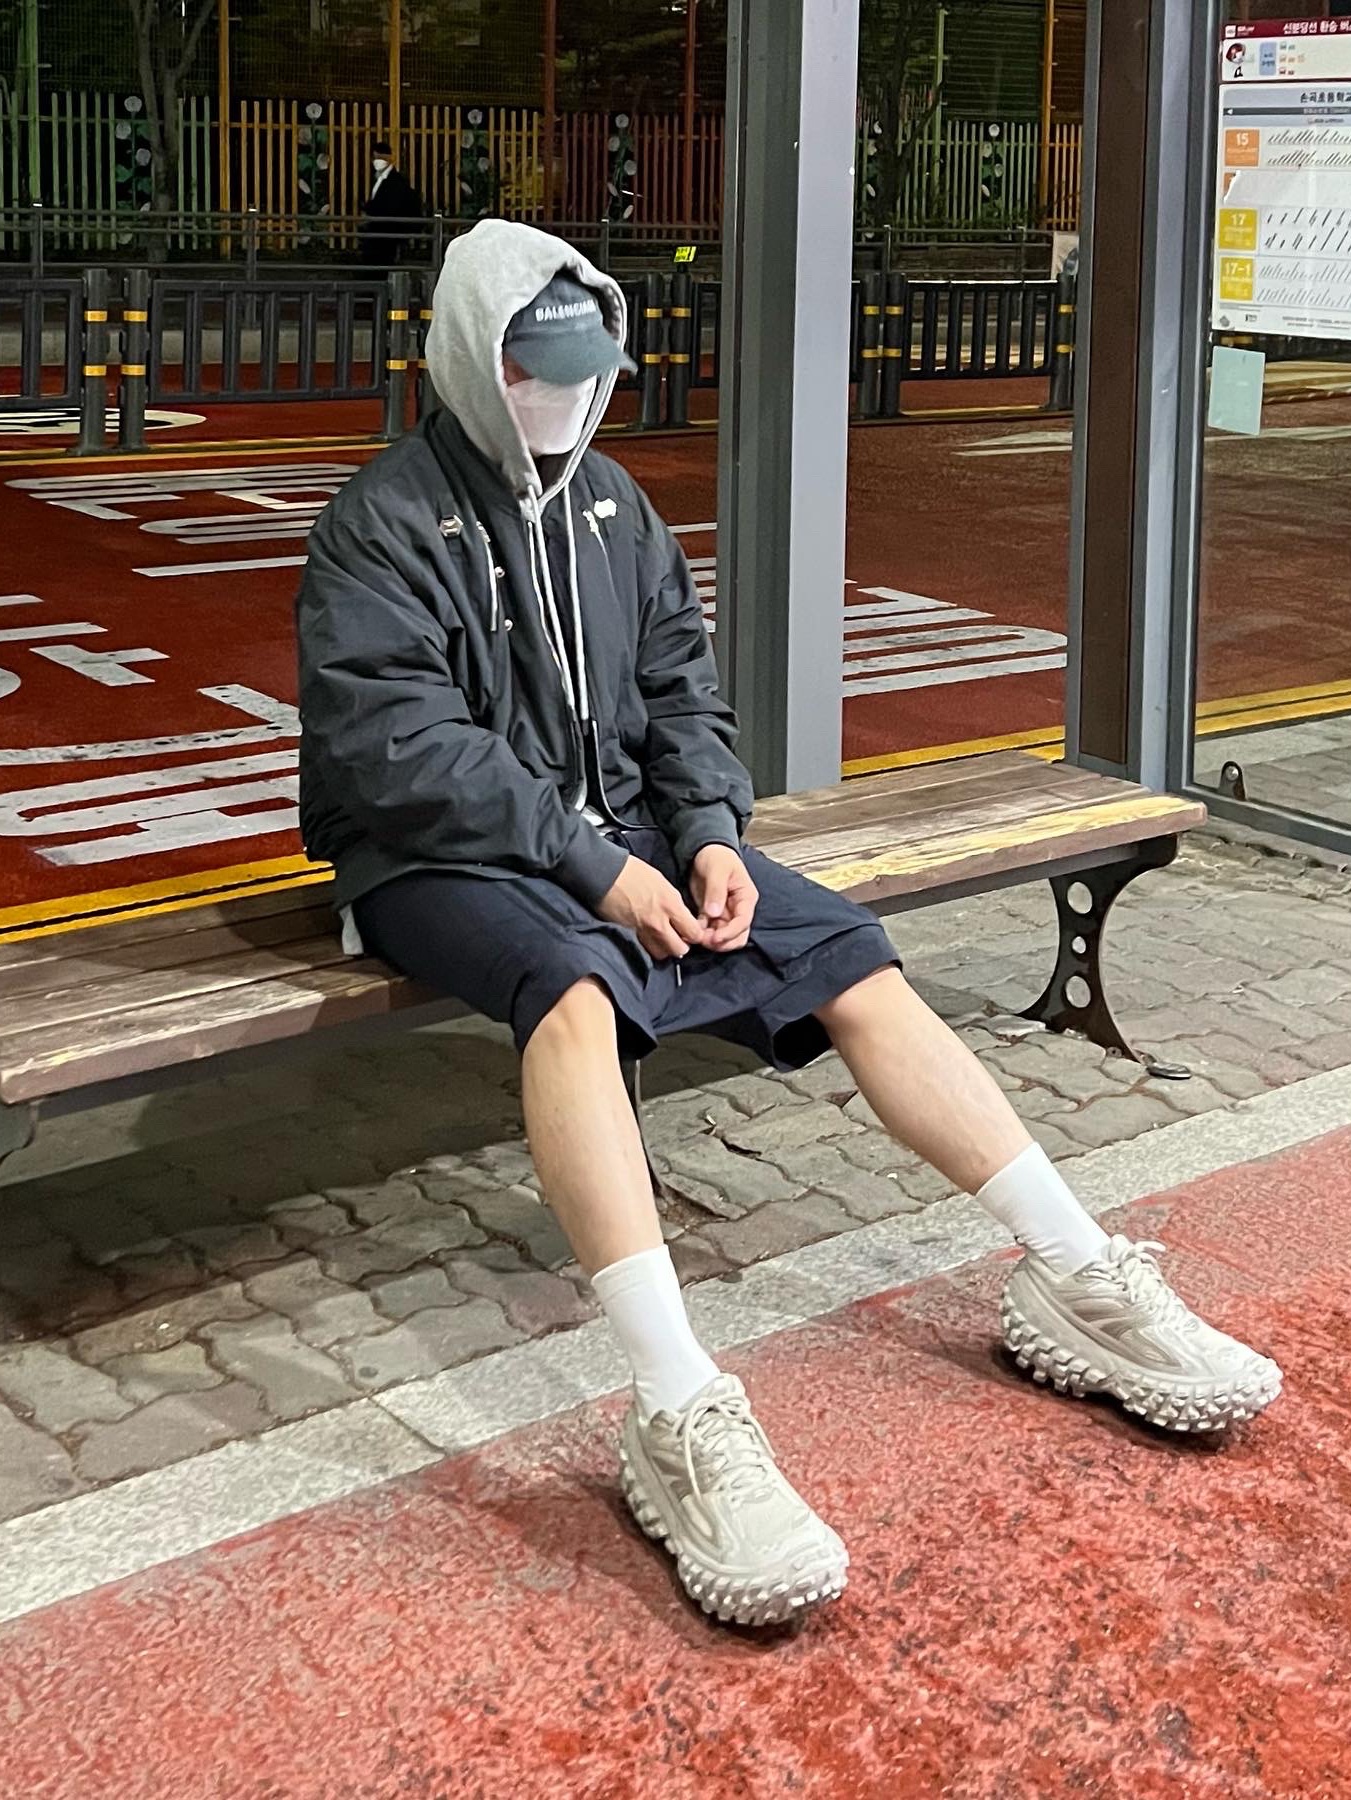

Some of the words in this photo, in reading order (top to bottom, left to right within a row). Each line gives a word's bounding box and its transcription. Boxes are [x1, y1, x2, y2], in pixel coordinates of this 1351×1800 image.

[1283, 22, 1318, 35] 신분당선
[1340, 20, 1351, 32] 버
[1236, 132, 1249, 146] 15
[1230, 213, 1246, 226] 17
[1225, 262, 1252, 276] 17-1
